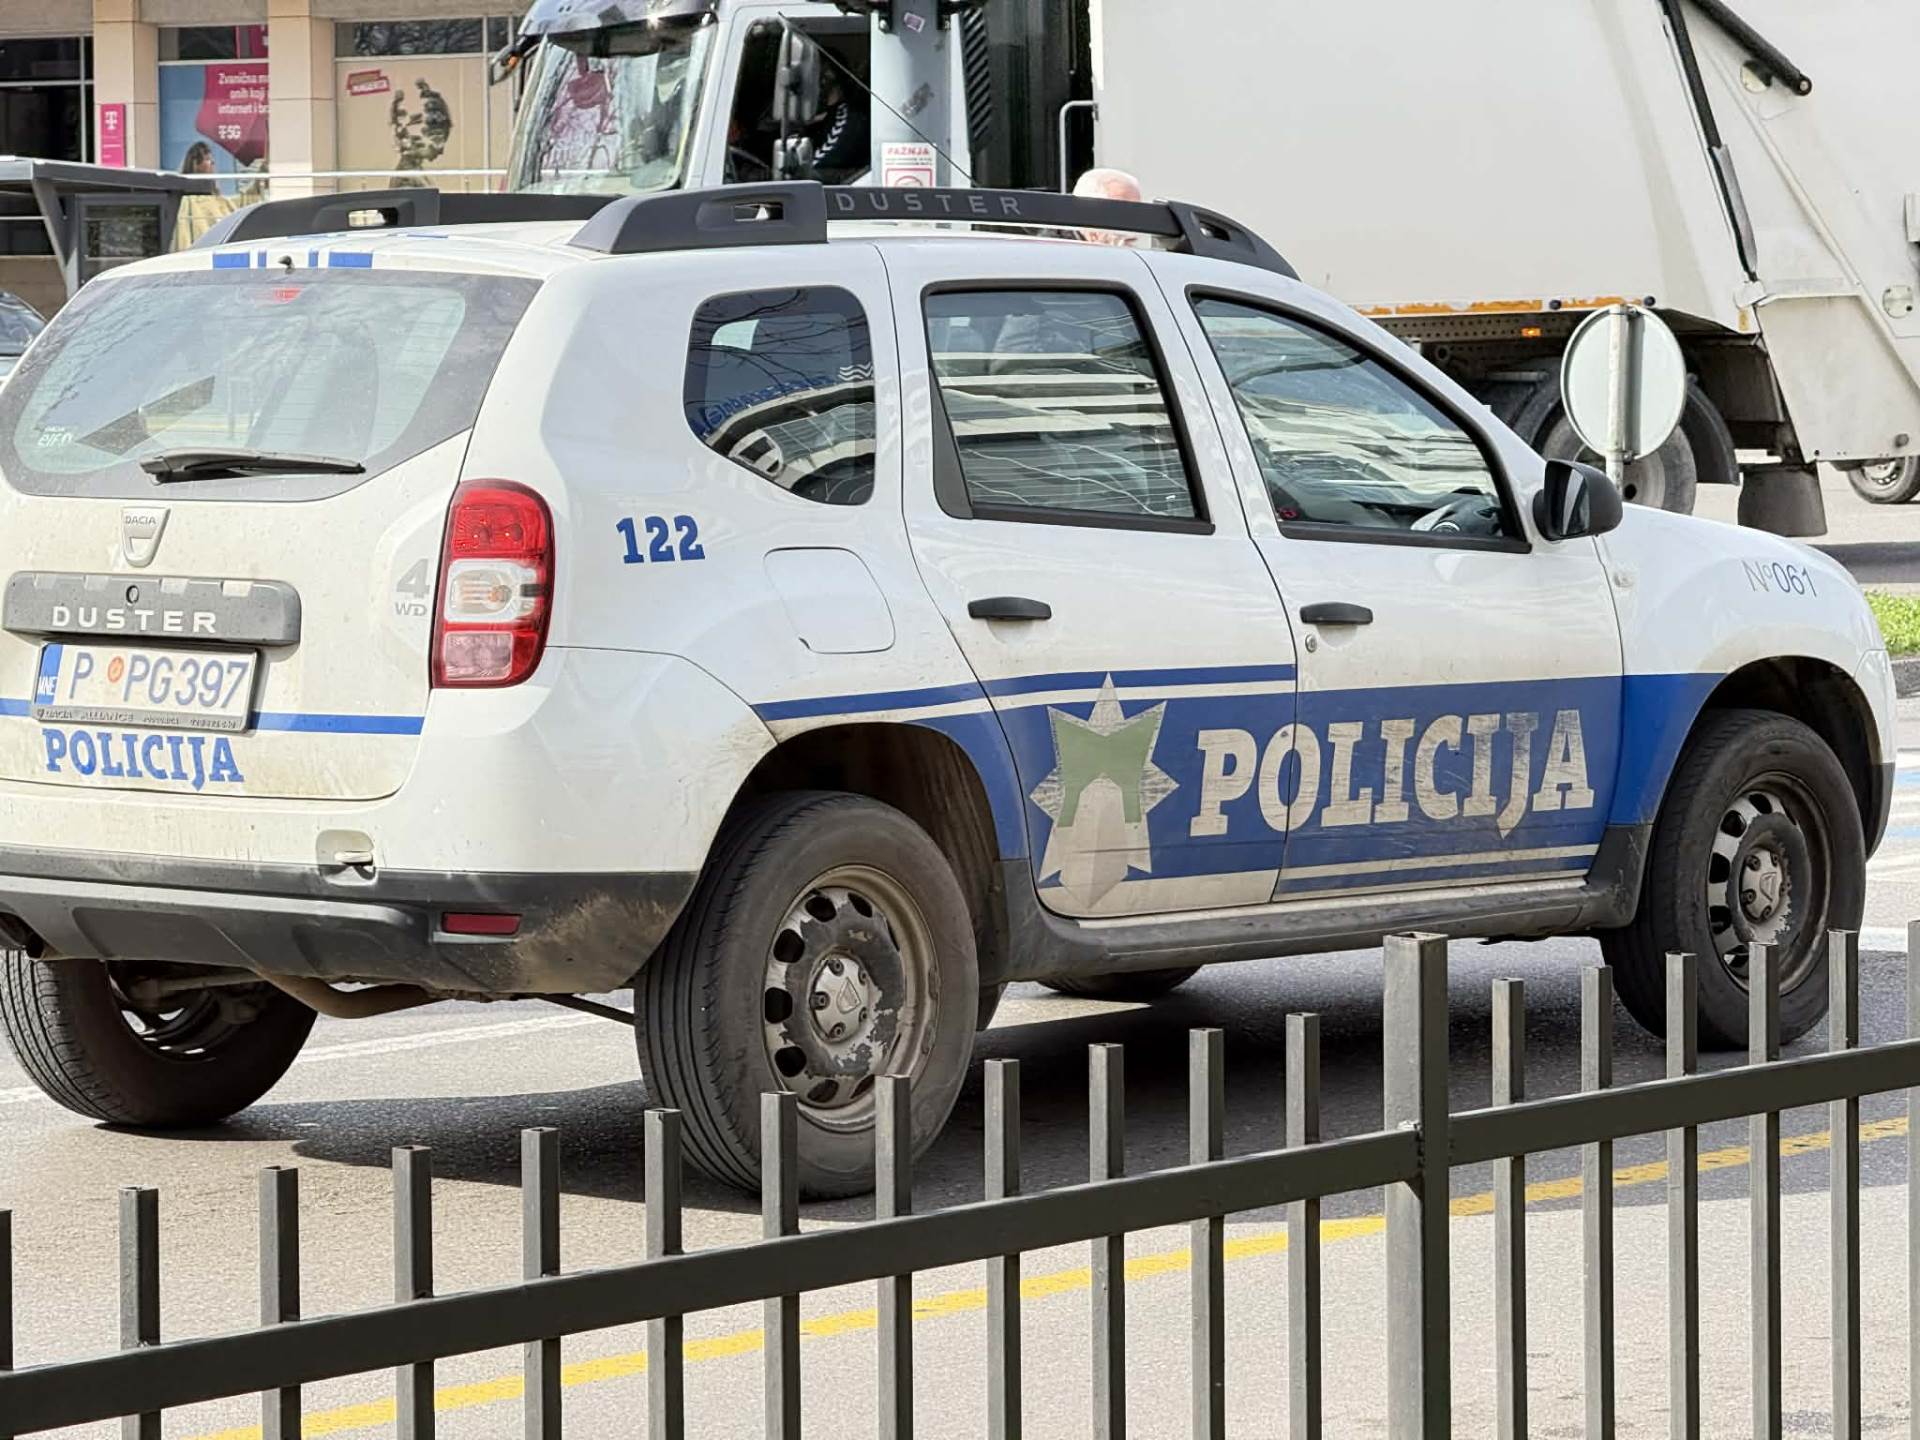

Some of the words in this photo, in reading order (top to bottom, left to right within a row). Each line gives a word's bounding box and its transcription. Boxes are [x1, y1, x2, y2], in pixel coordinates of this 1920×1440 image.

[836, 193, 1021, 215] DUSTER
[125, 515, 157, 525] DACIA
[615, 514, 706, 564] 122
[396, 557, 431, 599] 4
[51, 606, 217, 633] DUSTER
[395, 601, 428, 617] WD
[69, 652, 94, 699] P
[123, 654, 250, 709] PG397
[41, 727, 245, 792] POLICIJA
[1189, 709, 1596, 840] POLICIJA
